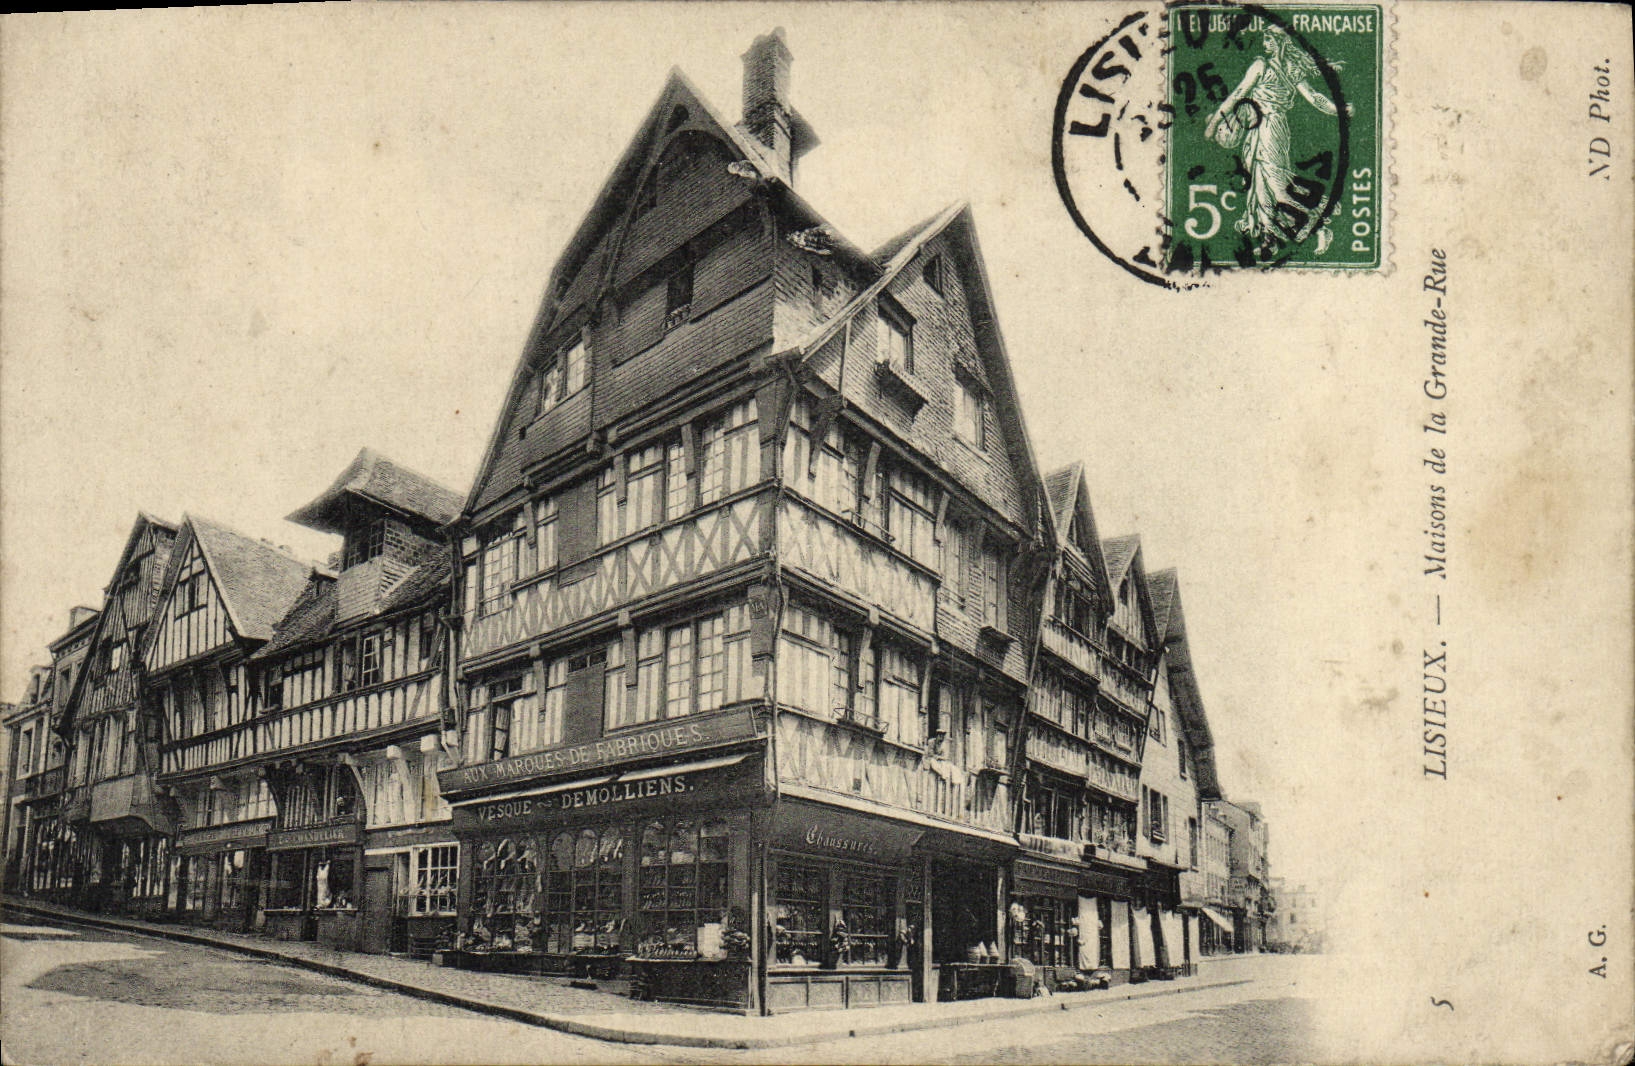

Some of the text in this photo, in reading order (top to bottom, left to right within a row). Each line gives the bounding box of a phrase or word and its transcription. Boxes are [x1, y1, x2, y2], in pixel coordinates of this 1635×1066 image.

[1293, 13, 1374, 35] FRANÇAISE
[1352, 167, 1373, 252] POSTES
[463, 766, 489, 784] AUX
[495, 751, 564, 778] MARQUES
[569, 746, 589, 765] DE
[478, 800, 532, 821] VESQUE
